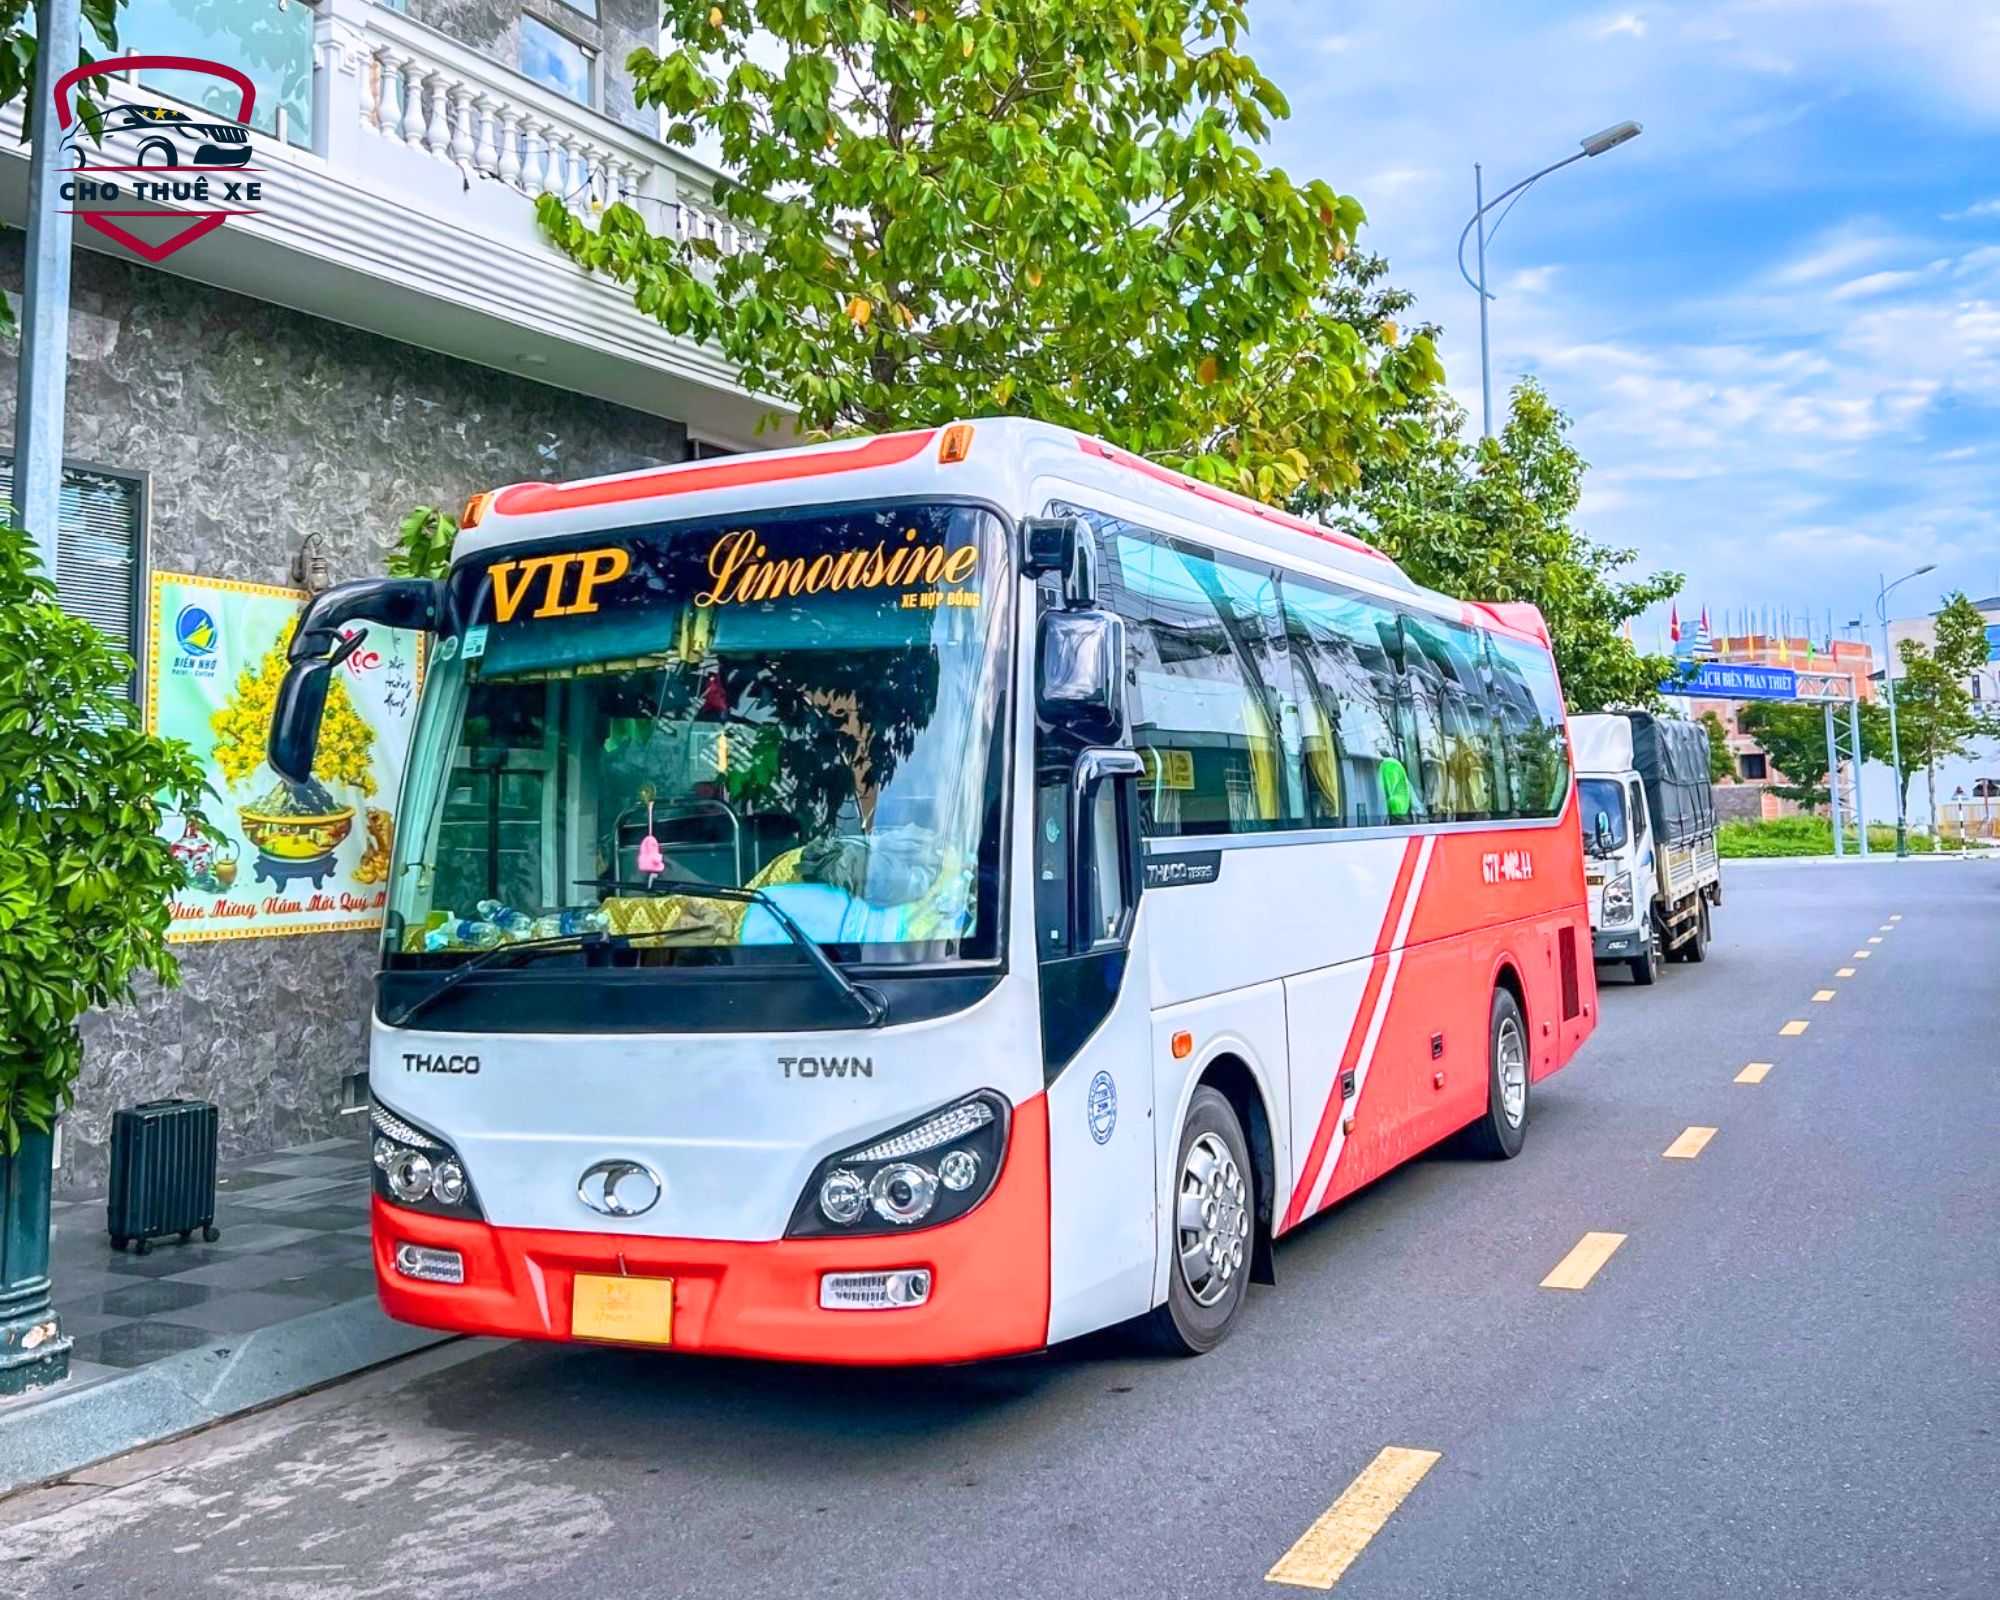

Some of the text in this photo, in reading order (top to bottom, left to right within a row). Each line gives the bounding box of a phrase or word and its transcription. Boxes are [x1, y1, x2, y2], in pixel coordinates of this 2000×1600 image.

[694, 527, 979, 608] Limousine
[487, 548, 630, 623] VIP
[901, 593, 918, 609] XE
[402, 1053, 481, 1075] THACO
[777, 1057, 874, 1078] TOWN
